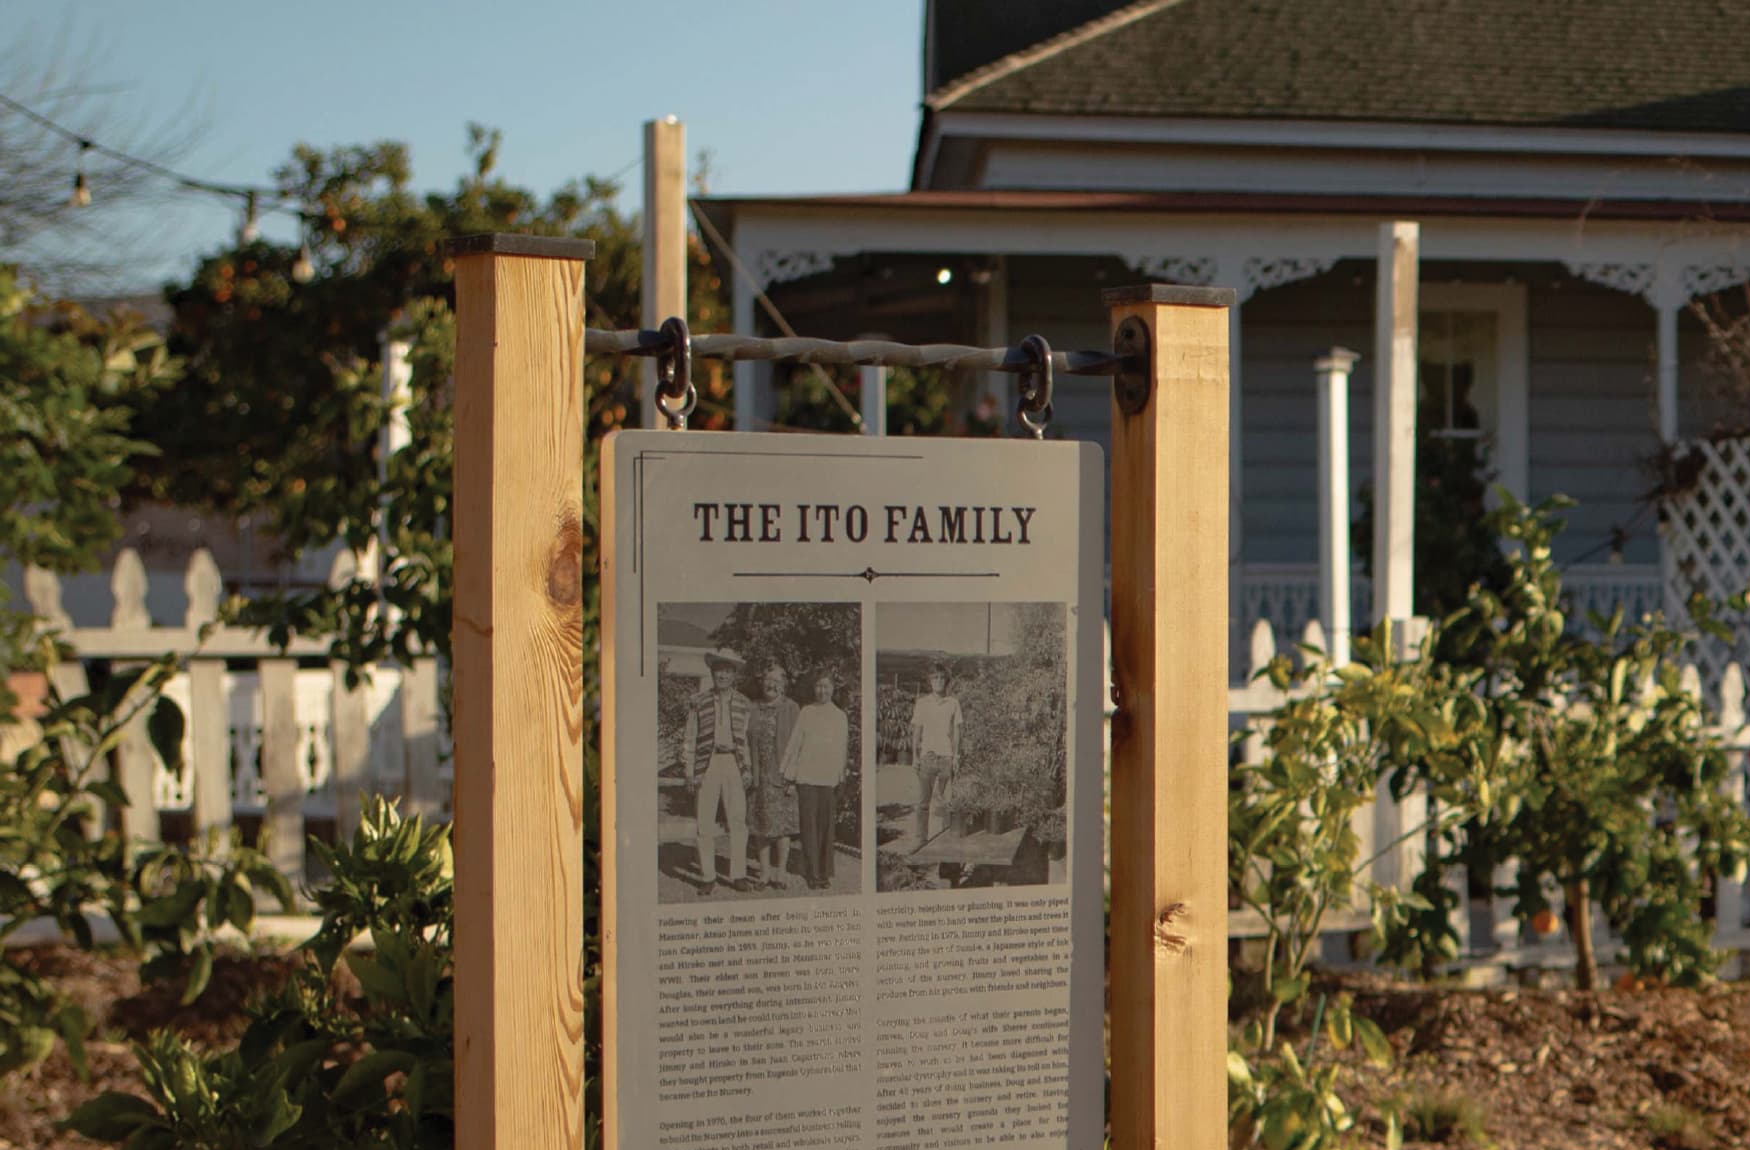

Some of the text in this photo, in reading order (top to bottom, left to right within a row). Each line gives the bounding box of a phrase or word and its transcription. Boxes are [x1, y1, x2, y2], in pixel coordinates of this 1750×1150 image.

[693, 503, 1036, 545] THE ITO FAMILY
[710, 1000, 752, 1012] everything
[729, 1115, 742, 1124] the
